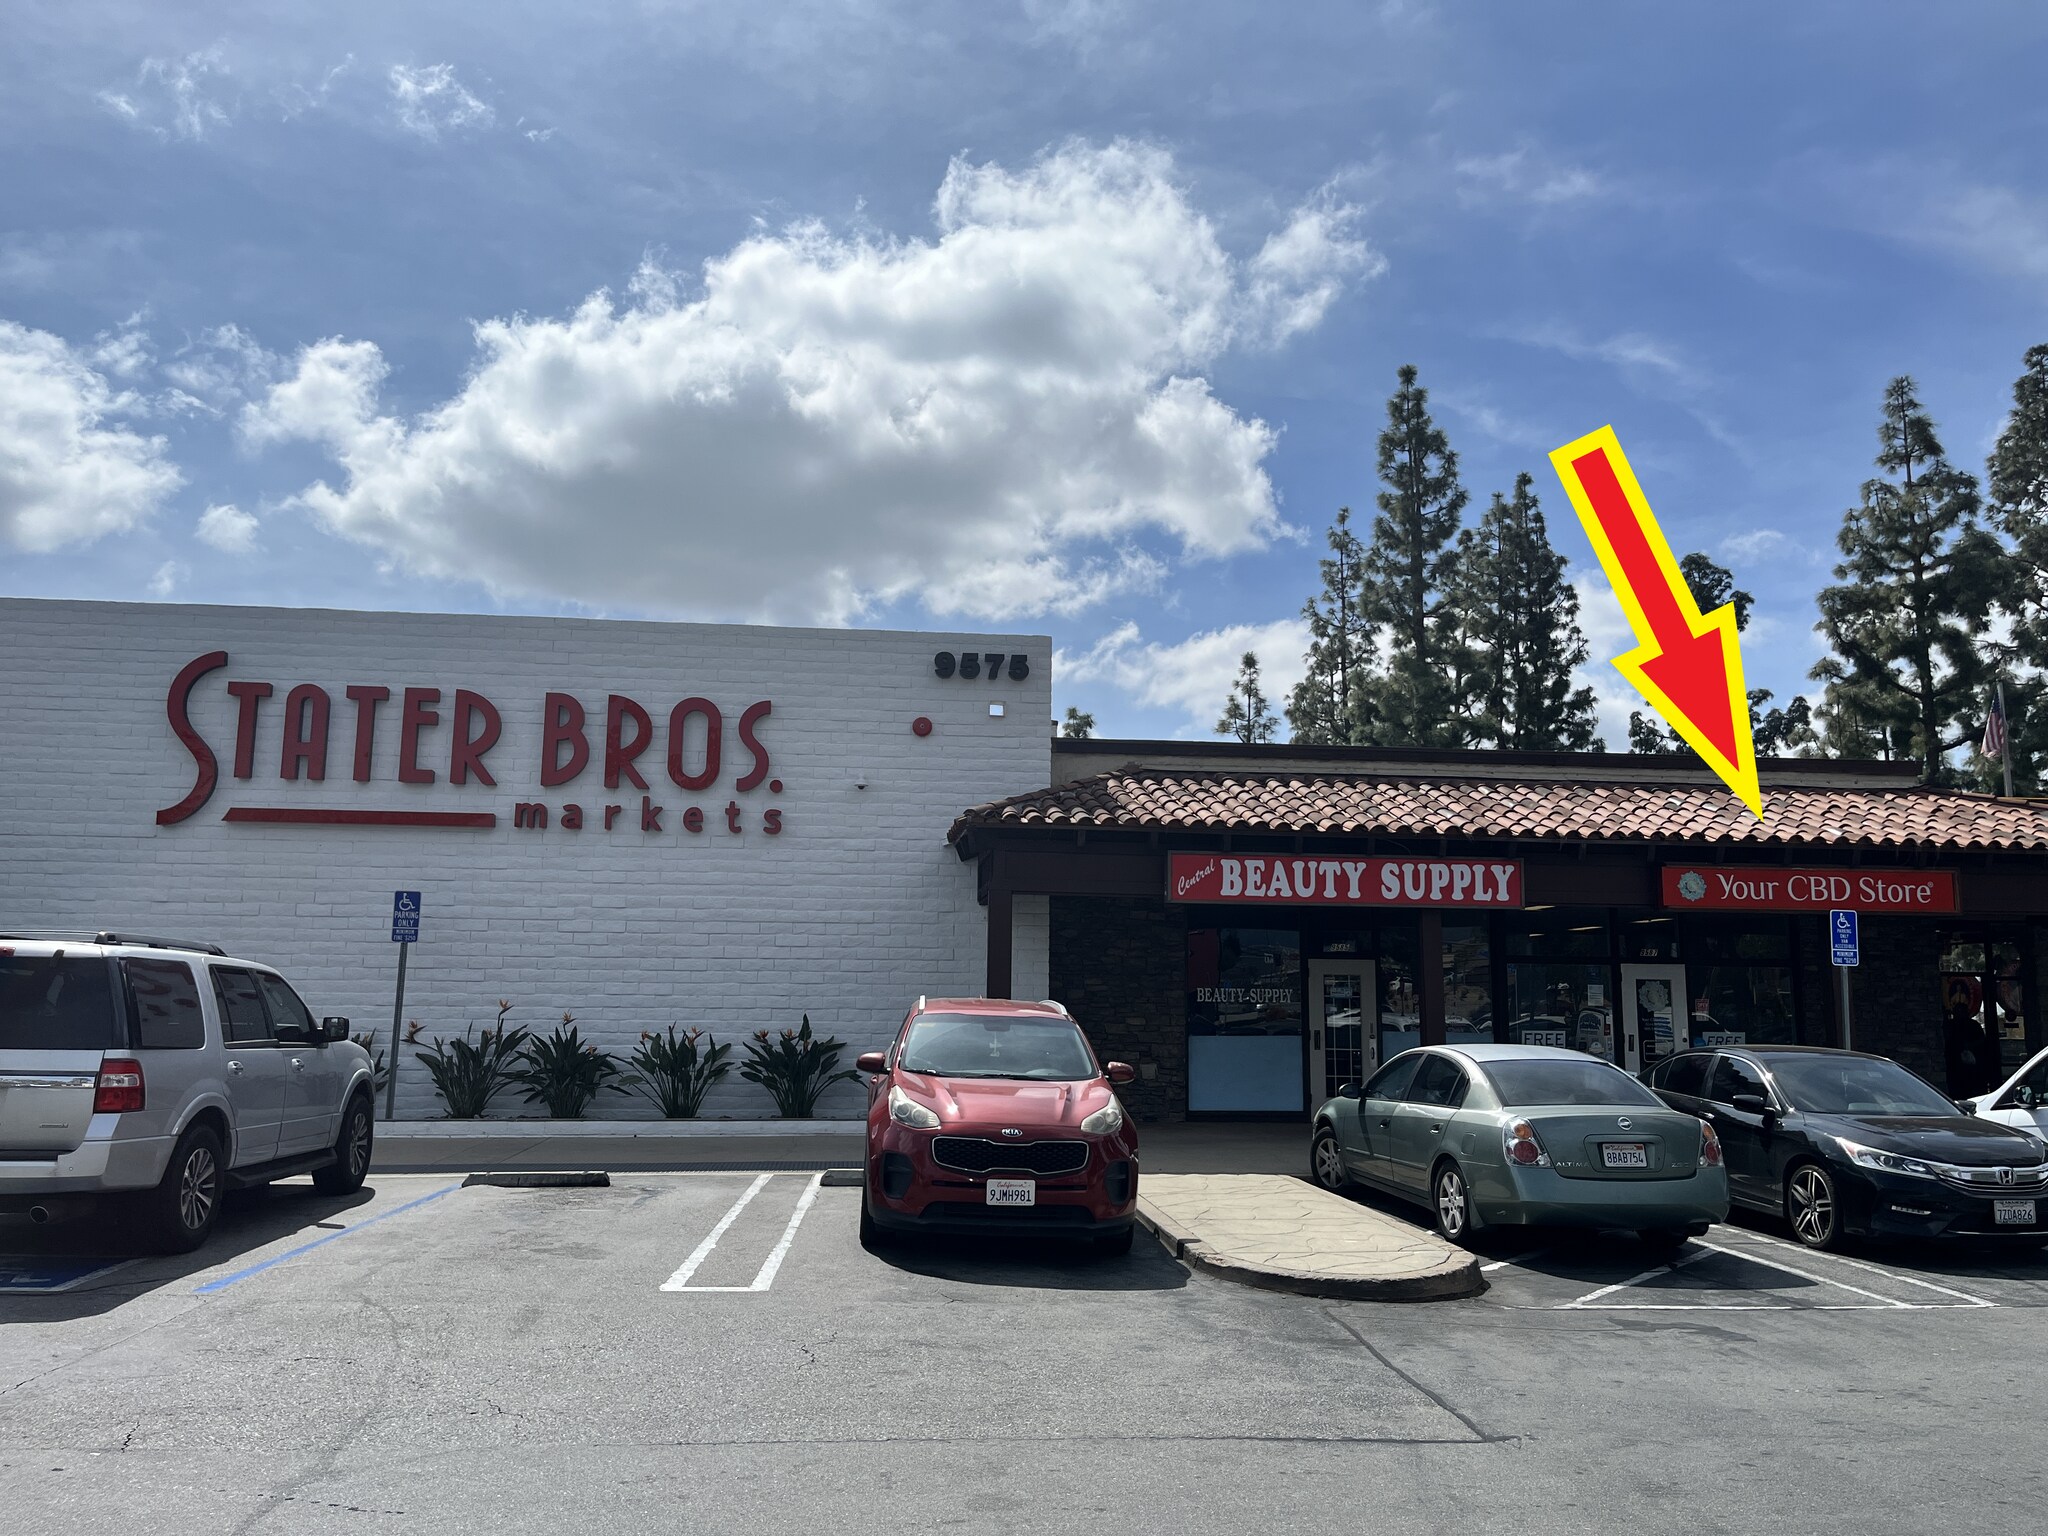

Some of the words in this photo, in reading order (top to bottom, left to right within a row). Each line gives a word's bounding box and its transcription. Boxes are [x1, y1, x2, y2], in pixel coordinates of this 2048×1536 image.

[934, 651, 1029, 682] 9575
[156, 650, 502, 825] STATER
[541, 691, 784, 794] BROS.
[514, 796, 782, 834] markets
[1177, 858, 1215, 896] Central
[1220, 858, 1367, 898] BEAUTY
[1380, 862, 1516, 902] SUPPLY
[1716, 874, 1780, 899] Your
[1787, 875, 1850, 901] CBD
[1196, 987, 1245, 1003] BEAUTY
[1249, 988, 1293, 1003] SUPPLY
[1524, 1032, 1565, 1046] FREE
[1707, 1036, 1743, 1045] FREE
[1606, 1152, 1644, 1163] 8BAB754
[997, 1181, 1025, 1189] California
[990, 1189, 1032, 1202] 9JMH981
